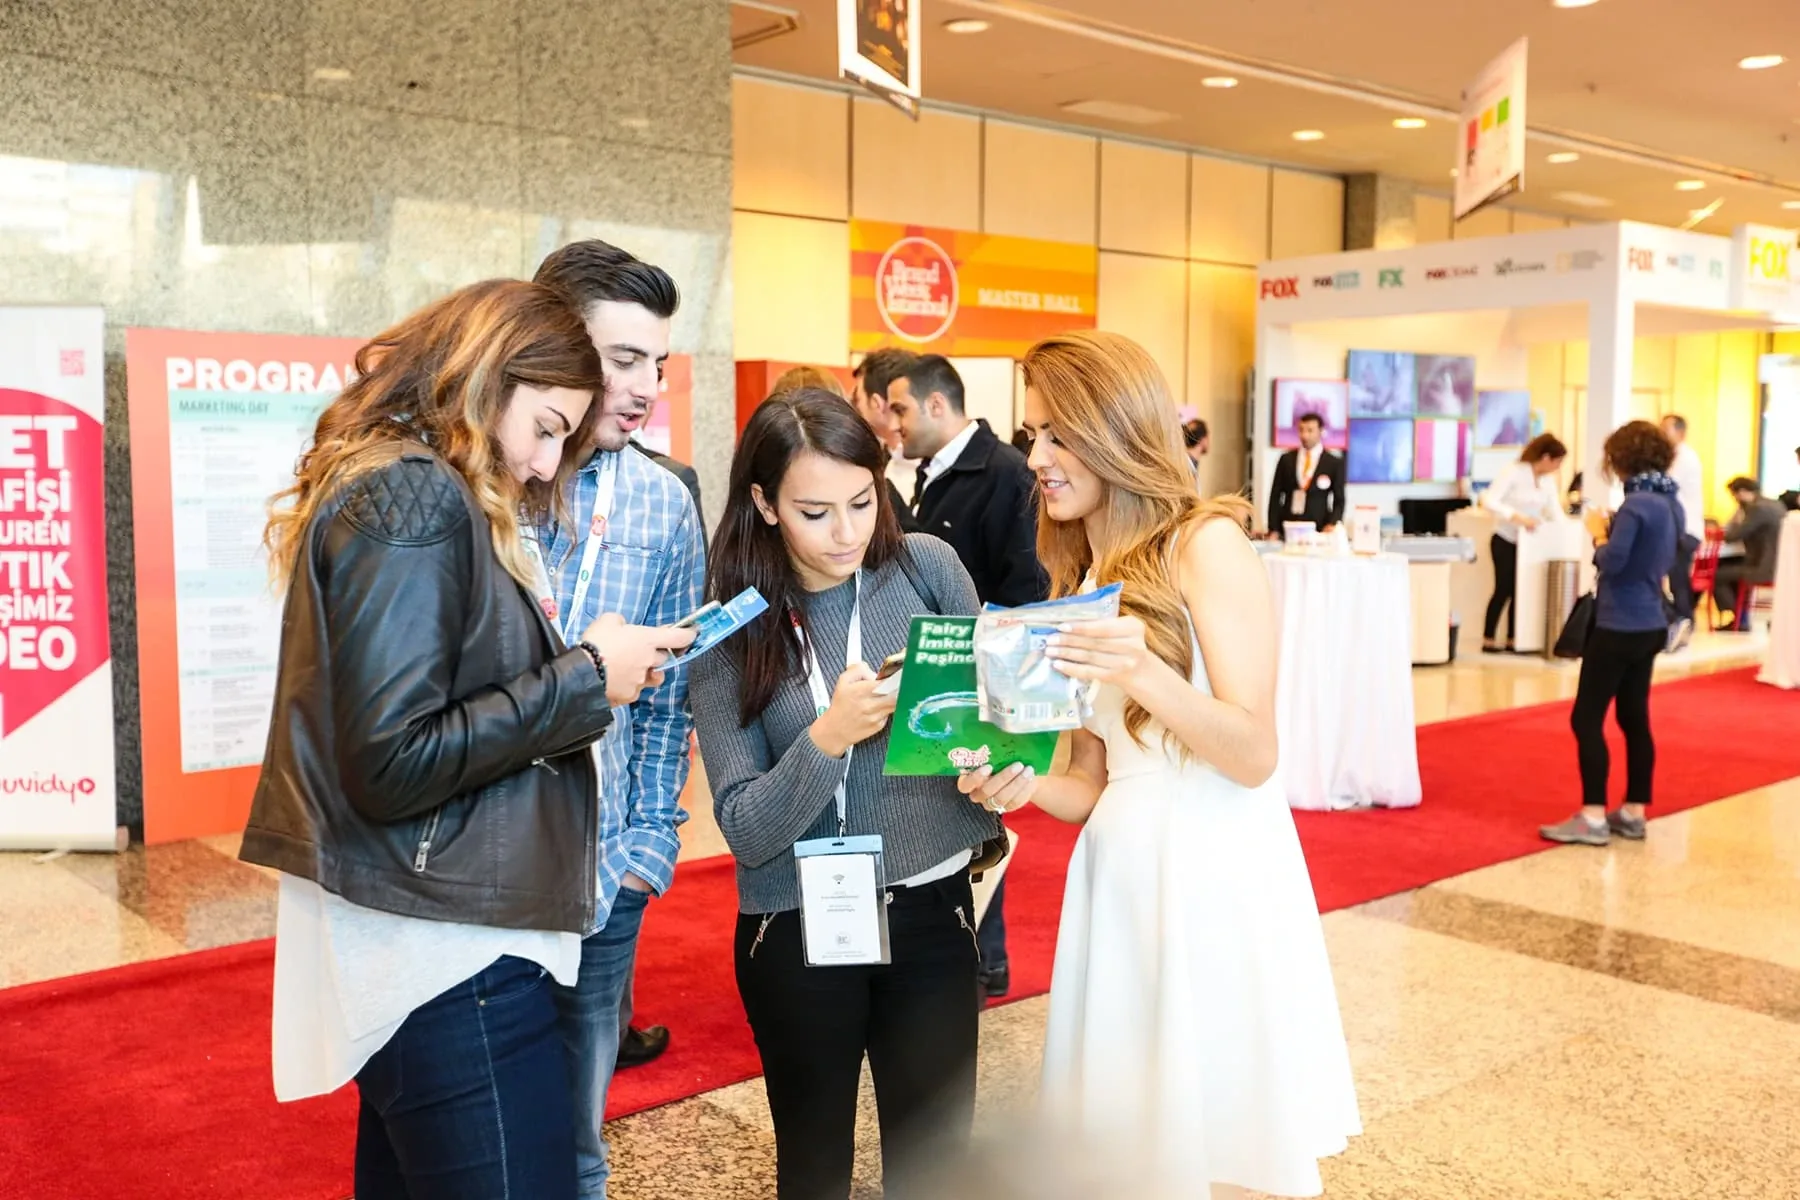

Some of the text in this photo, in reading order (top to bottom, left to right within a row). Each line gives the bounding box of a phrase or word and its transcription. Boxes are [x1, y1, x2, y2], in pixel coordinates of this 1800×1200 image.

[1751, 236, 1791, 280] FOX
[1260, 276, 1299, 300] FOX
[1378, 268, 1403, 288] FX
[978, 287, 1083, 314] MASTER HALL
[178, 400, 270, 414] MARKETING DAY
[0, 469, 71, 520] FİŞİ
[0, 551, 73, 589] TIK
[921, 621, 971, 637] Fairy
[0, 625, 76, 671] EO
[0, 771, 95, 804] uvidyo
